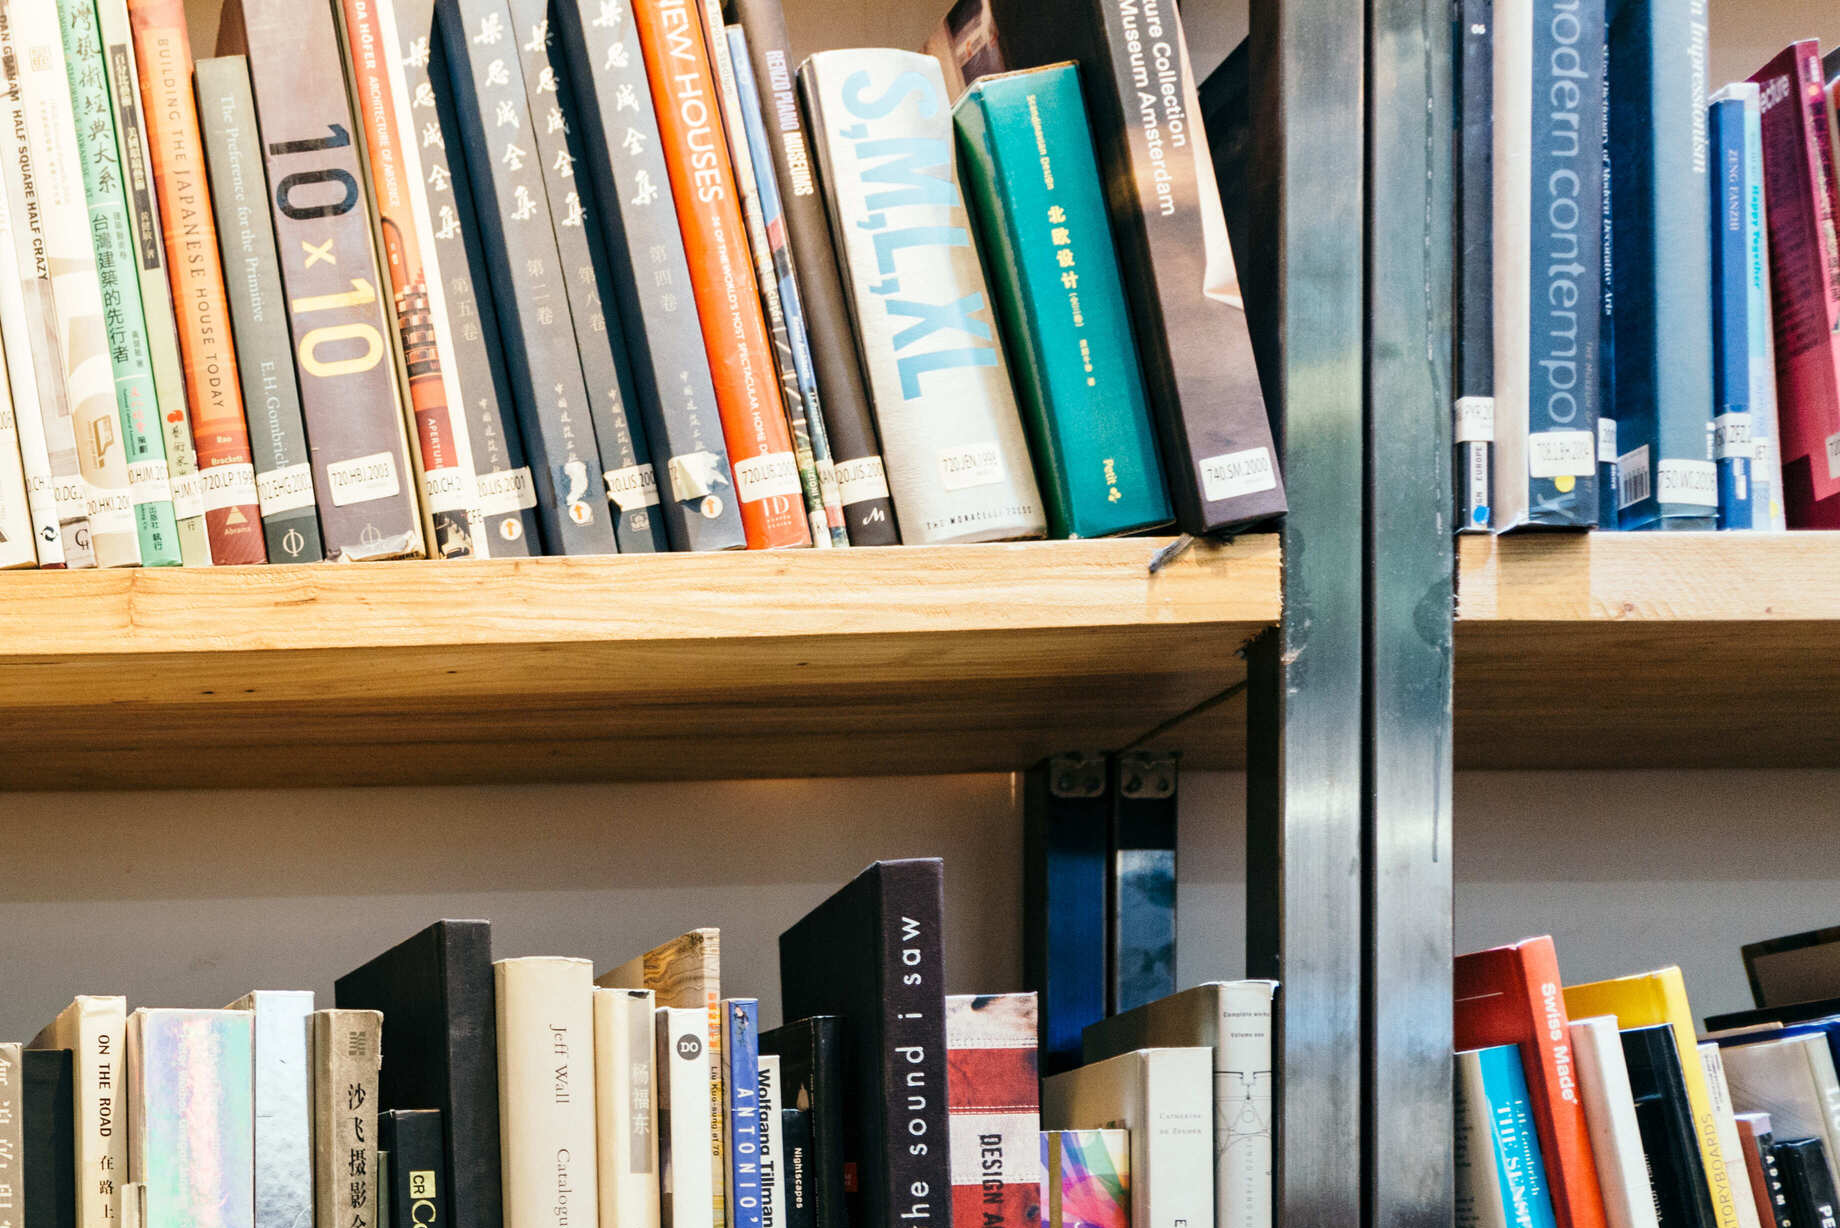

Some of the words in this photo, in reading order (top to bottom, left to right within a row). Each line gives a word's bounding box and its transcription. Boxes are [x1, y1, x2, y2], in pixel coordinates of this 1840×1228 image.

[0, 42, 21, 103] GRAHAM
[156, 37, 182, 124] BUILDING
[764, 50, 793, 91] RENZO
[1152, 48, 1188, 149] Collection
[11, 109, 27, 144] HALF
[673, 73, 724, 203] HOUSES
[774, 91, 800, 130] PIANO
[170, 128, 188, 162] THE
[782, 131, 814, 197] MUSEUMS
[1026, 94, 1050, 156] Scandinavian
[1039, 157, 1056, 191] Design
[1137, 91, 1177, 216] Amsterdam
[14, 145, 34, 200] SQUARE
[23, 201, 39, 236] HALF
[173, 169, 205, 280] JAPANESE
[29, 237, 49, 282] CRAZY
[193, 287, 217, 346] HOUSE
[202, 352, 225, 409] TODAY
[1102, 457, 1118, 486] Petit
[901, 917, 922, 986] saw
[548, 1023, 569, 1057] Jeff
[897, 1012, 923, 1020] i
[553, 1064, 570, 1105] Wall
[894, 1046, 928, 1156] sound
[1496, 1101, 1520, 1151] THE
[979, 1134, 1004, 1204] DESIGN
